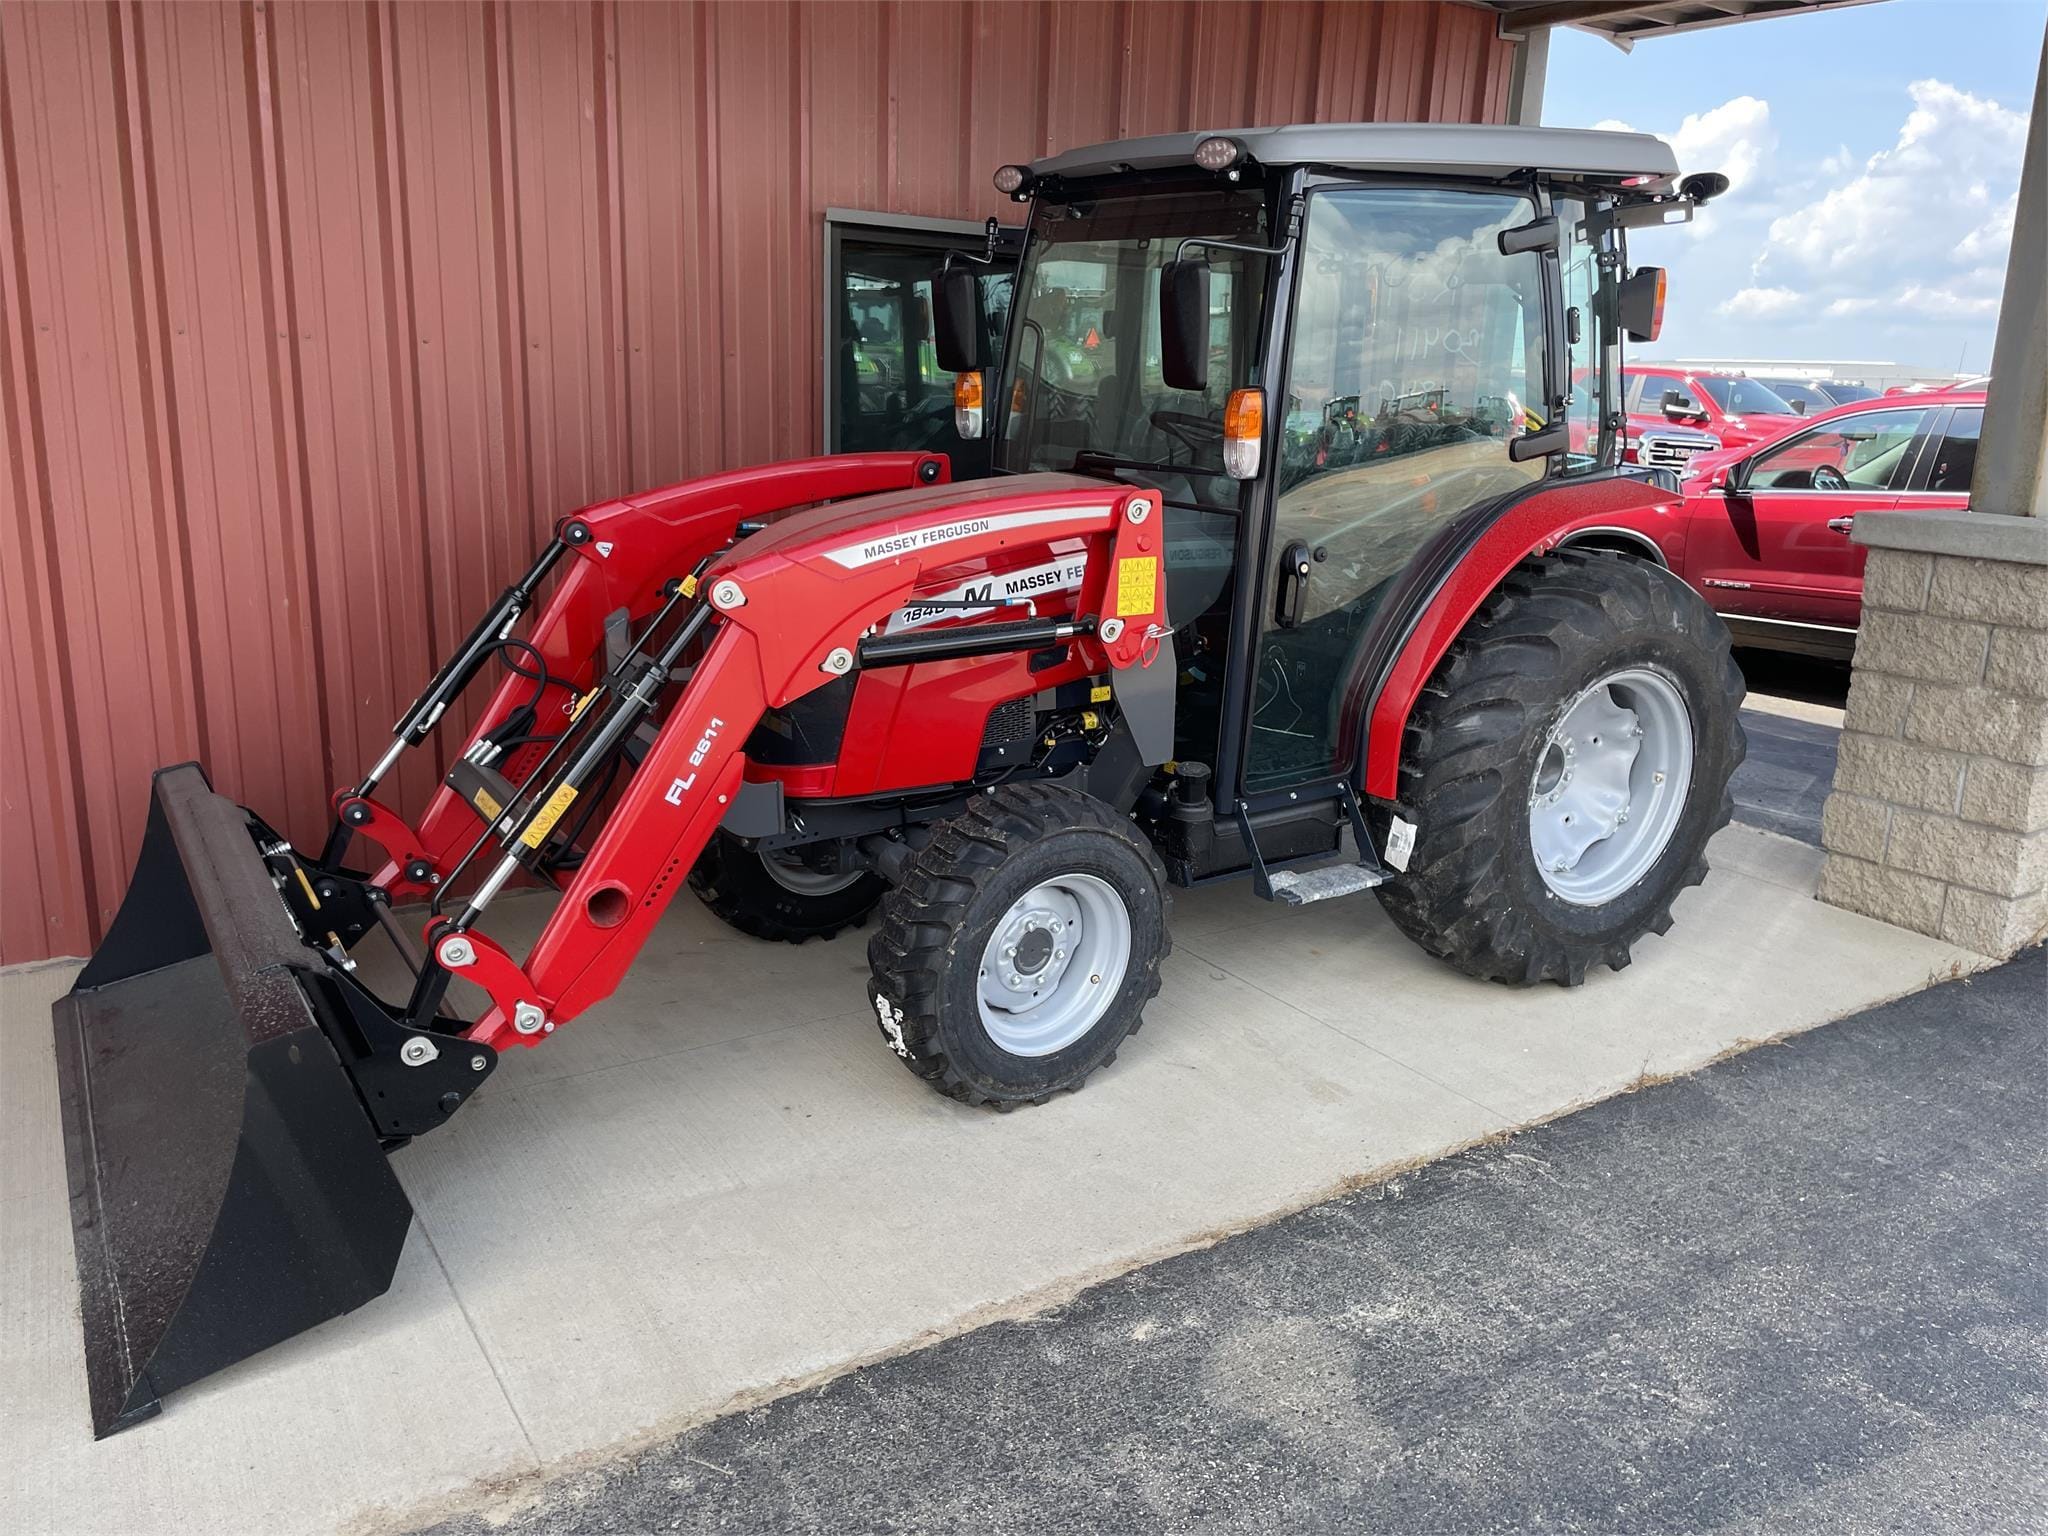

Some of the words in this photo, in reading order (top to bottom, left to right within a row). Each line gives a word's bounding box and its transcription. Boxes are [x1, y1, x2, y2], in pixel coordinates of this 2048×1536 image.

[863, 535, 918, 559] MASSEY
[922, 520, 989, 544] FERGUSON
[1005, 570, 1061, 595] MASSEY
[664, 772, 697, 806] FL
[689, 717, 725, 767] 2611
